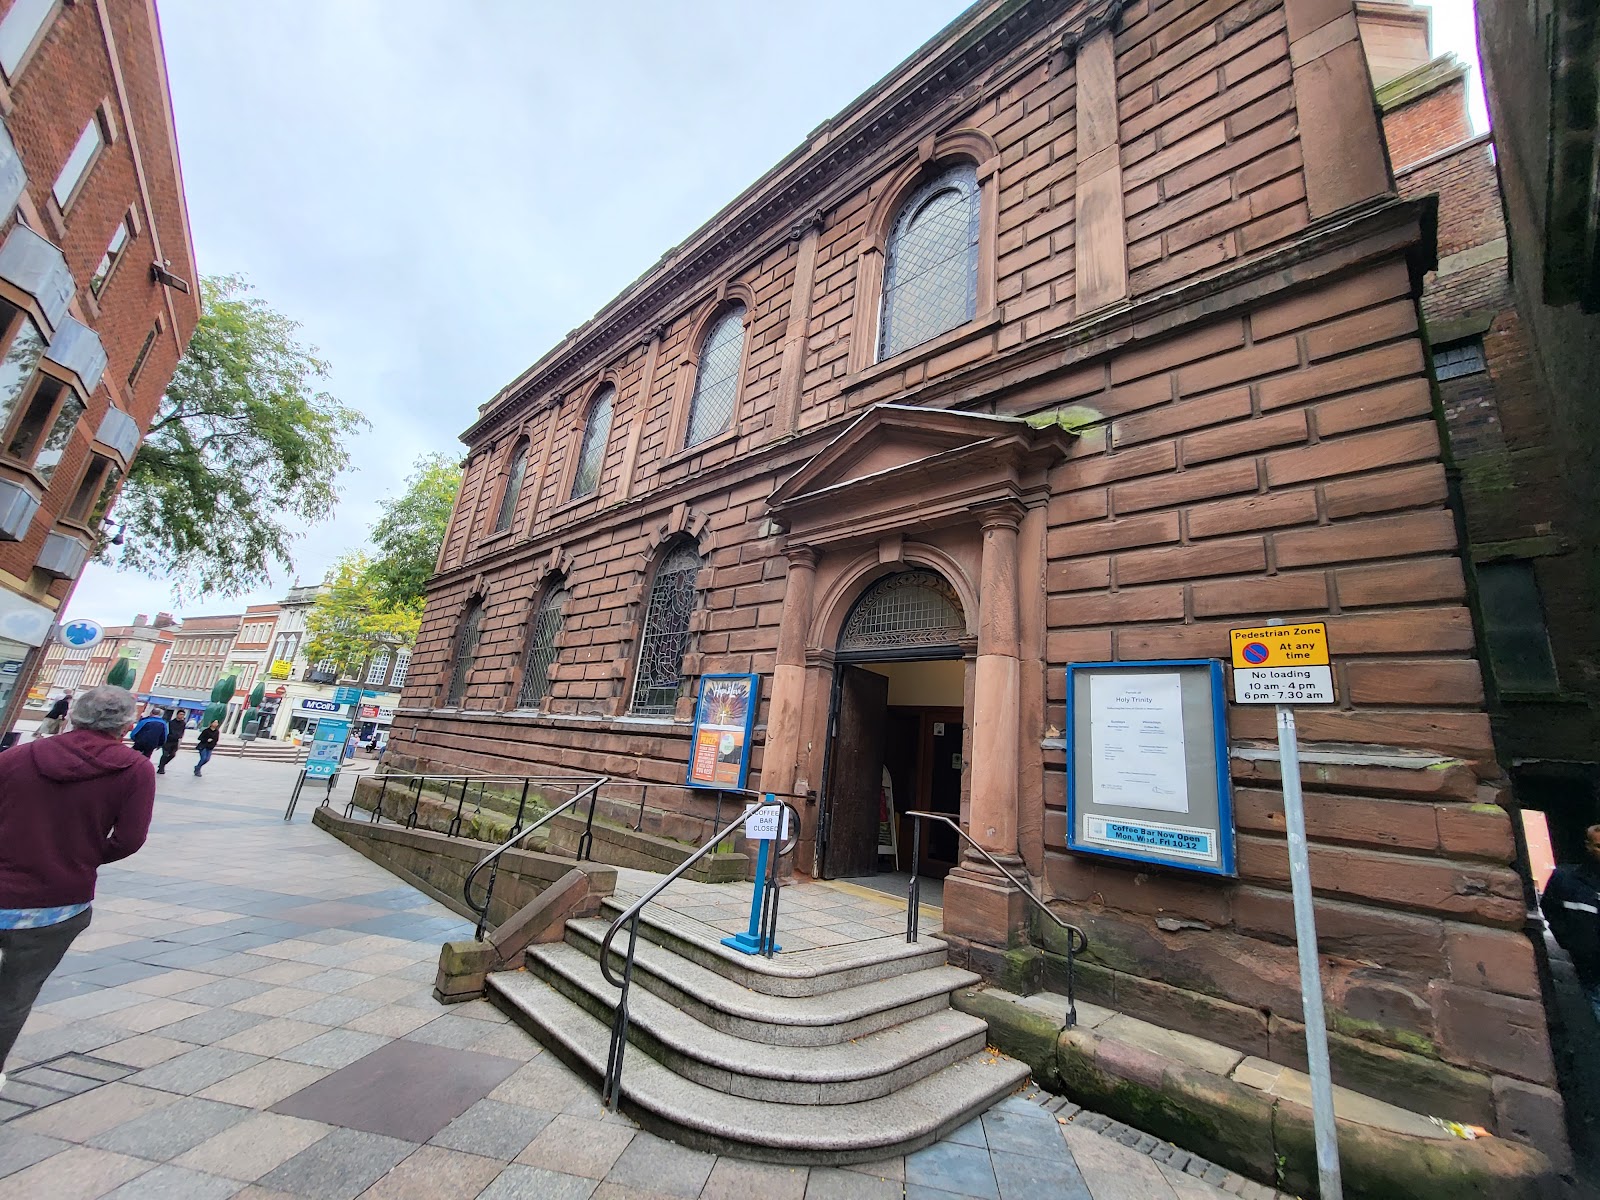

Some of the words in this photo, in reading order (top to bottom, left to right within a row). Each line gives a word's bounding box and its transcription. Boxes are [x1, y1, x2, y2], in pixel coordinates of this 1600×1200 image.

[1235, 630, 1290, 640] Pedestrian
[1295, 642, 1315, 650] any
[1252, 671, 1267, 679] No
[1270, 670, 1311, 679] loading
[1249, 682, 1261, 690] 10
[1298, 682, 1316, 690] pm
[1244, 691, 1251, 699] 6
[1253, 692, 1269, 700] pm
[1277, 691, 1304, 699] 7.30
[754, 809, 779, 817] COFFEE
[1112, 824, 1139, 834] Coffee
[1140, 828, 1155, 836] Bar
[1157, 830, 1175, 839] Now
[1177, 833, 1201, 843] Open
[1159, 838, 1171, 846] Fri
[1172, 840, 1198, 850] 10-12
